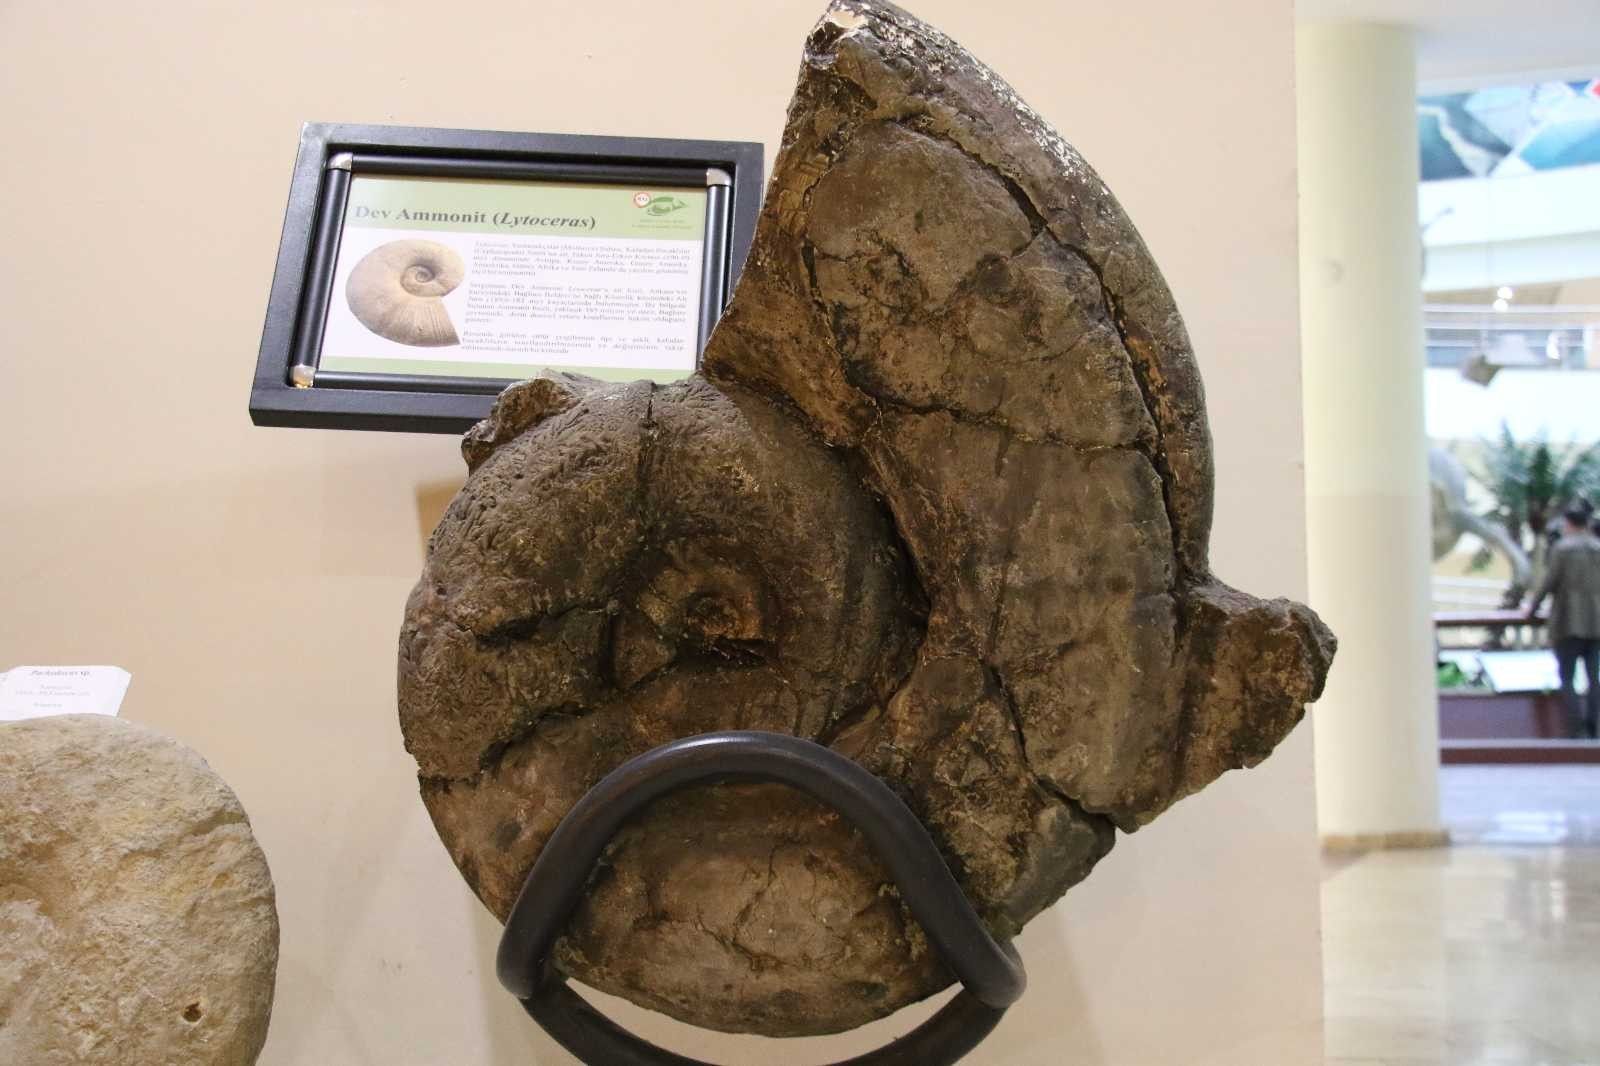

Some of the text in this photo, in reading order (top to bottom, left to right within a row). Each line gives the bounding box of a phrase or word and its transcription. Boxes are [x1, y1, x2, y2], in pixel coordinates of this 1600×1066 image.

[354, 205, 597, 230] Dev Ammonit (Lytoceras)
